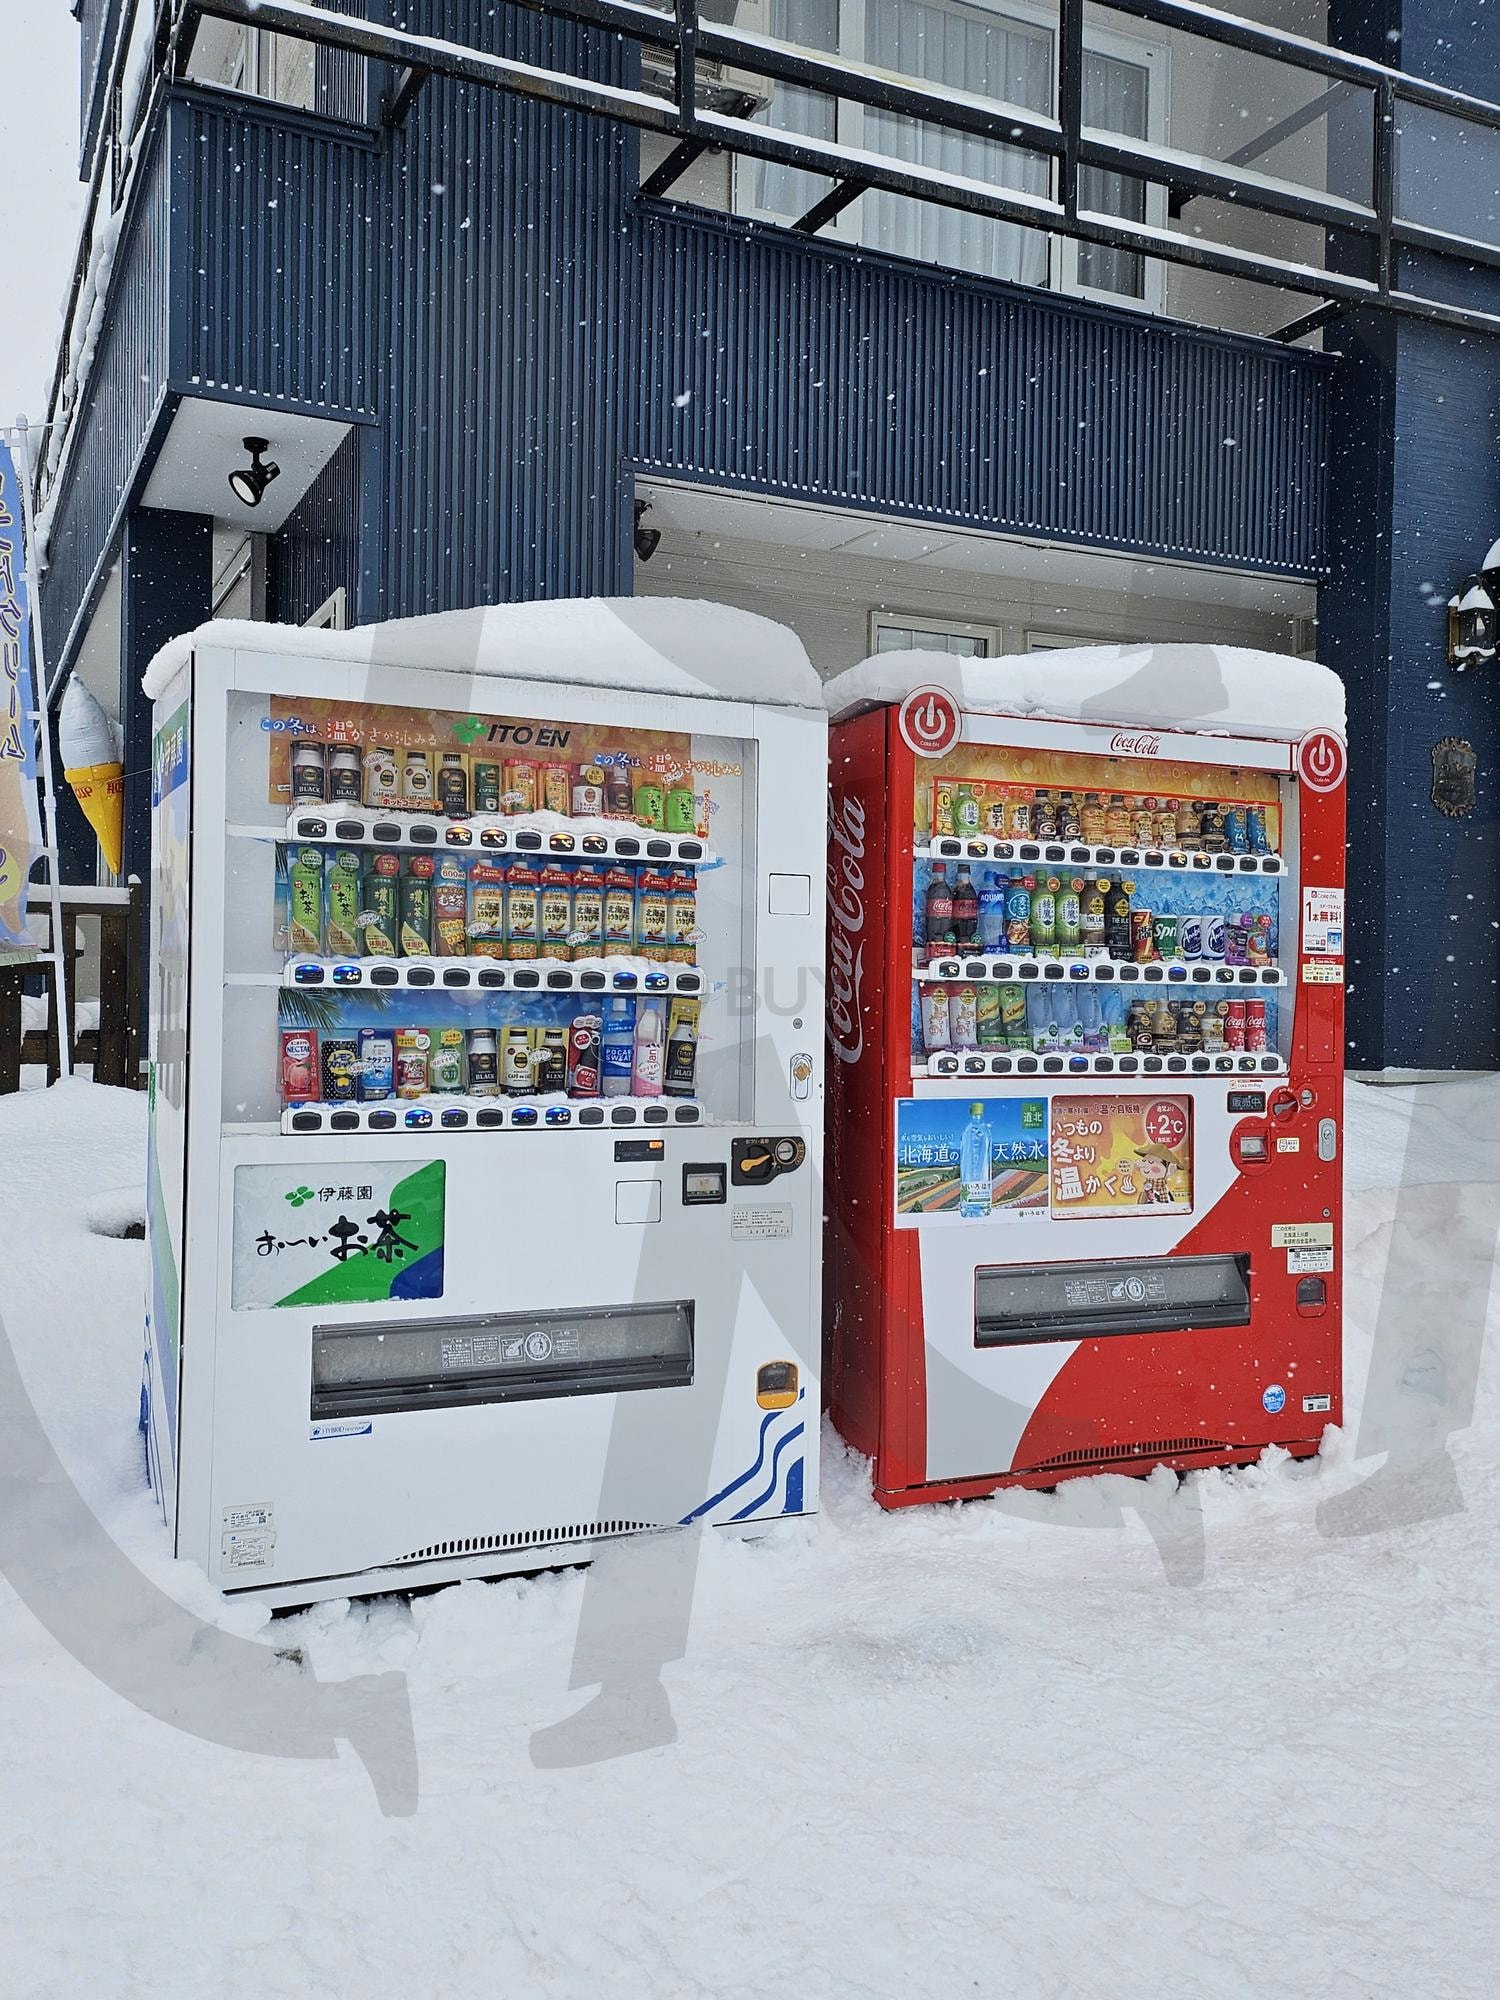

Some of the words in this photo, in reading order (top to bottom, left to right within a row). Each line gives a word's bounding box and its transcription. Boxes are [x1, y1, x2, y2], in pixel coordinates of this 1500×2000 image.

[487, 724, 533, 745] ITO
[535, 729, 571, 748] EN
[1110, 732, 1162, 756] Coca-Cola
[299, 786, 321, 794] BLACK
[336, 789, 358, 797] BLACK
[382, 798, 431, 808] ホットコーナー
[602, 813, 645, 824] ホットコーナー
[439, 894, 465, 907] むぎ茶
[477, 902, 500, 911] 北海道
[511, 903, 535, 912] 北海道
[544, 905, 568, 914] 北海道
[576, 906, 600, 915] 北海道
[607, 905, 630, 914] 北海道
[645, 908, 666, 917] 北海道
[675, 909, 695, 917] 北海道
[1305, 901, 1342, 923] 1本無料!
[825, 793, 867, 1065] Coca-Cola
[674, 1069, 693, 1077] BLACK
[1232, 1096, 1263, 1110] 販売中
[1023, 1111, 1043, 1123] 道北
[1052, 1119, 1103, 1136] いつもの
[900, 1144, 960, 1166] 北海道の
[993, 1140, 1045, 1161] 天然水
[1052, 1137, 1096, 1163] 冬より
[1053, 1166, 1117, 1200] 温かく
[317, 1185, 373, 1202] 伊藤園
